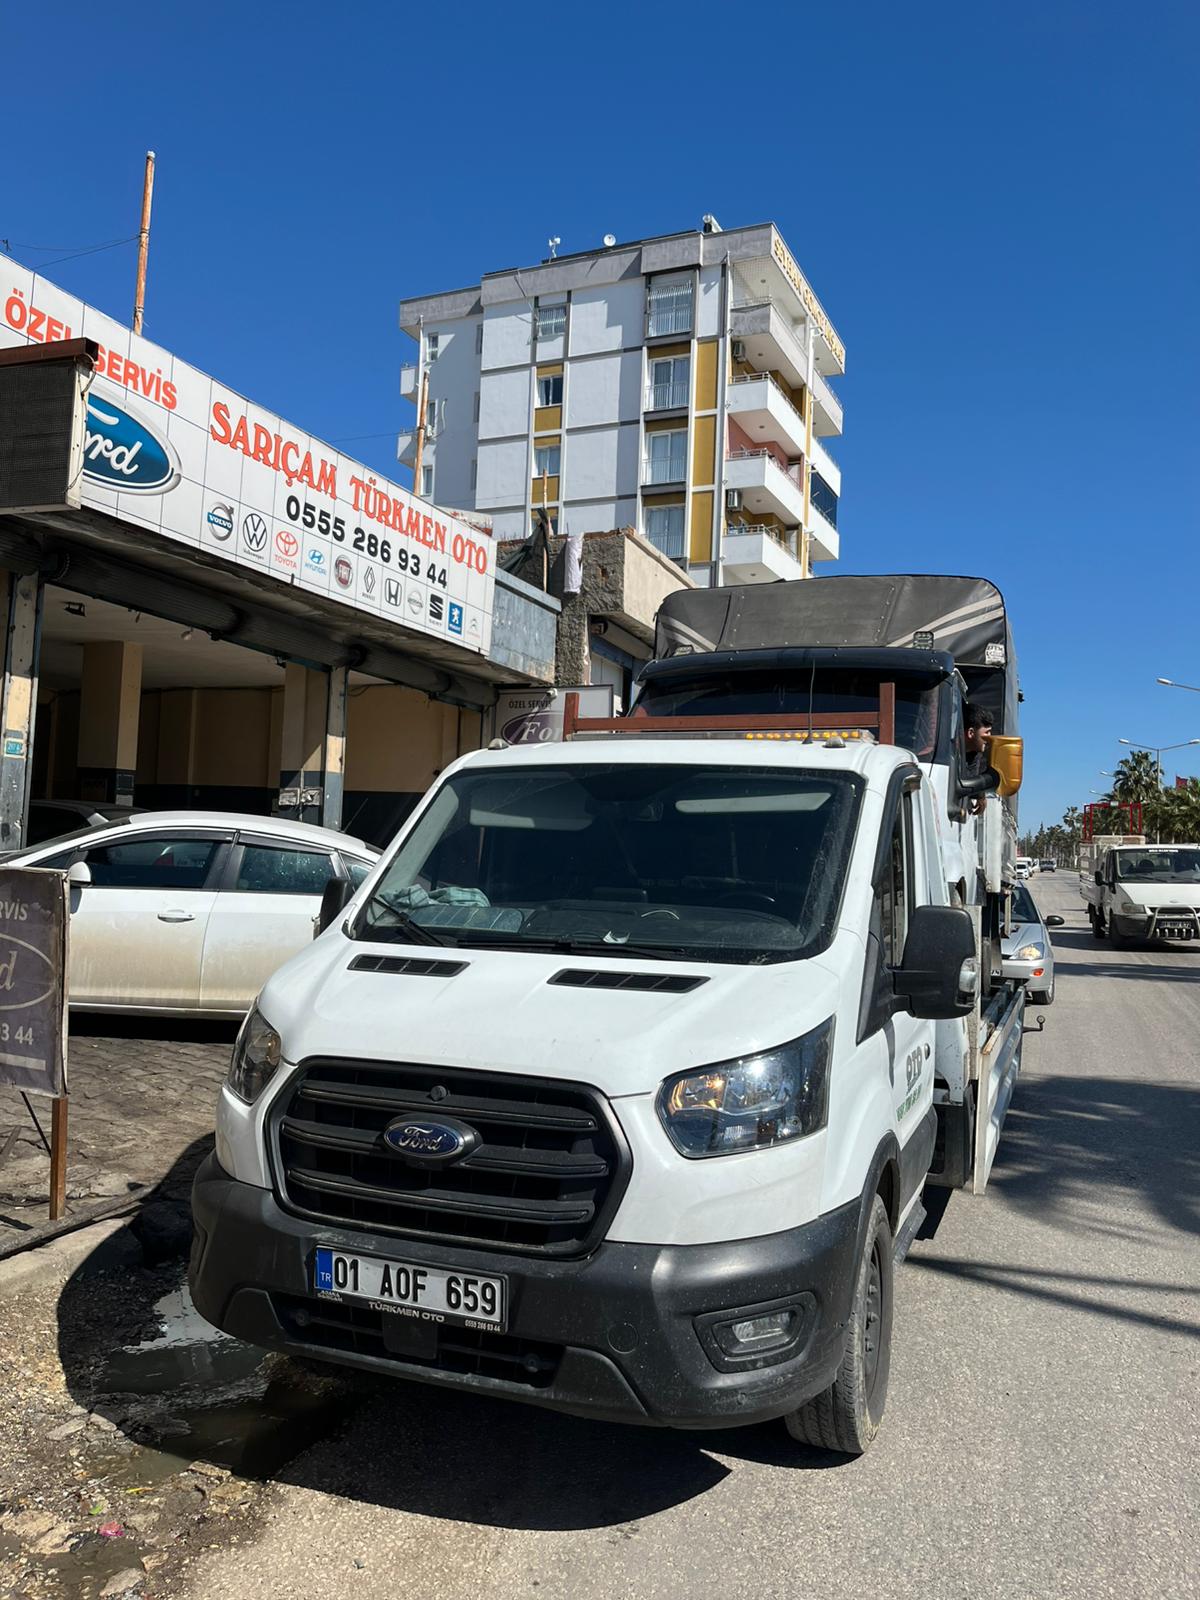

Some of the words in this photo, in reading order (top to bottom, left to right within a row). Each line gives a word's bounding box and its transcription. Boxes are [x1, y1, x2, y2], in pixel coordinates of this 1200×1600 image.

[210, 401, 337, 500] SARIÇAM
[350, 476, 447, 555] TÜRKMEN
[453, 534, 488, 575] OTO
[208, 514, 233, 530] VOLVO
[286, 495, 346, 543] 0555
[352, 527, 392, 563] 286
[398, 548, 421, 577] 93
[426, 563, 447, 589] 44
[274, 554, 298, 569] TOYOTA
[14, 1026, 34, 1046] 44
[399, 1126, 443, 1151] Ford
[320, 1272, 331, 1282] TR
[334, 1256, 359, 1291] 01
[380, 1264, 427, 1302] AOF
[446, 1276, 496, 1315] 659
[368, 1301, 419, 1318] TÜRKMEN
[421, 1312, 445, 1323] OTO
